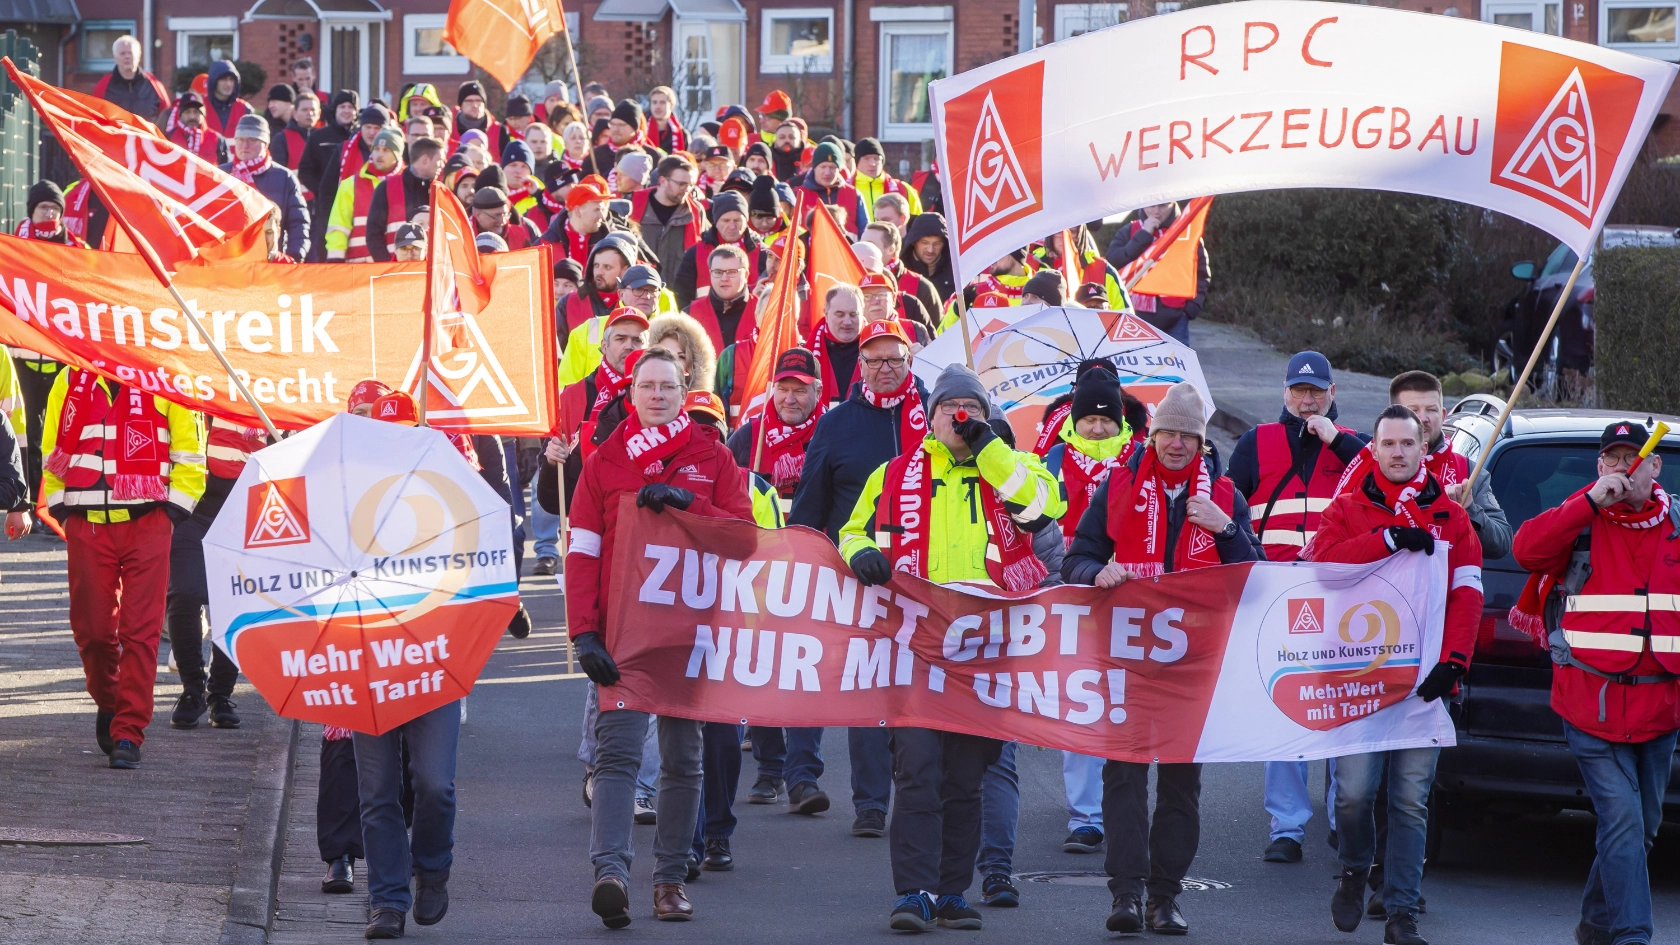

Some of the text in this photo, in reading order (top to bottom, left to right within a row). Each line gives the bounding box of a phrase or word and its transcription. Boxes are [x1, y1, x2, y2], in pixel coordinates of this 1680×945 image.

[1089, 106, 1479, 181] WERKZEUGBAU
[0, 274, 340, 353] Warnstreik
[228, 368, 340, 404] Recht
[1045, 421, 1054, 435] UND
[900, 494, 921, 546] YOU
[231, 549, 508, 596] HOLZ UND KUNSTSTOFF
[638, 543, 1189, 663] ZUKUNFT GIBT ES
[280, 634, 450, 678] Mehr Wert
[685, 624, 823, 692] NUR
[972, 668, 1127, 725] UNS!
[1277, 643, 1416, 662] HOLZ UND KUNSTSTOFF
[302, 670, 445, 707] mit Tarif
[1299, 681, 1386, 701] MehrWert
[1307, 699, 1381, 721] mit Tarif
